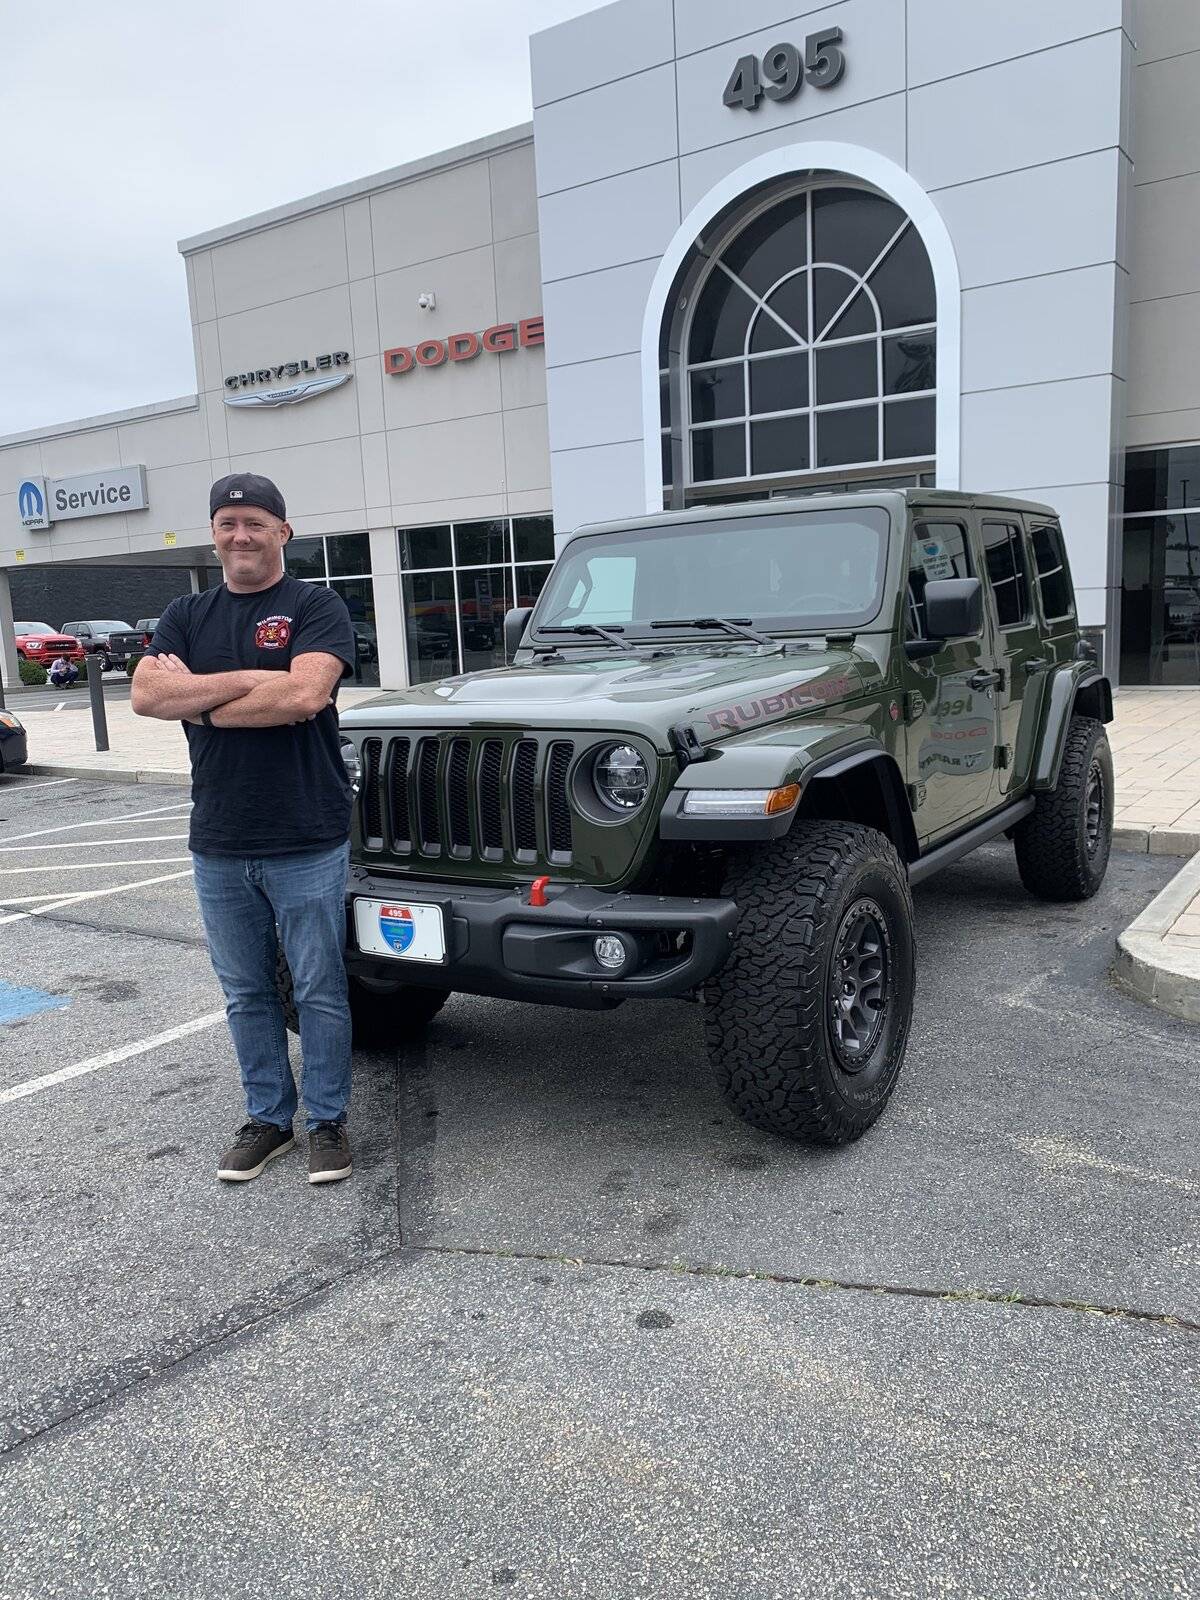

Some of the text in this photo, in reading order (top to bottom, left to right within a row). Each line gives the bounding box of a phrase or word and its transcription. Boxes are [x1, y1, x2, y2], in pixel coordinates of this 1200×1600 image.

[722, 26, 846, 111] 495
[383, 315, 545, 376] DODGE
[224, 350, 351, 390] CHRYSLER
[55, 482, 132, 511] Service
[22, 518, 45, 527] MOPAR
[256, 615, 293, 627] WILMINGTON
[706, 674, 850, 732] RUBICON
[388, 909, 403, 918] 495
